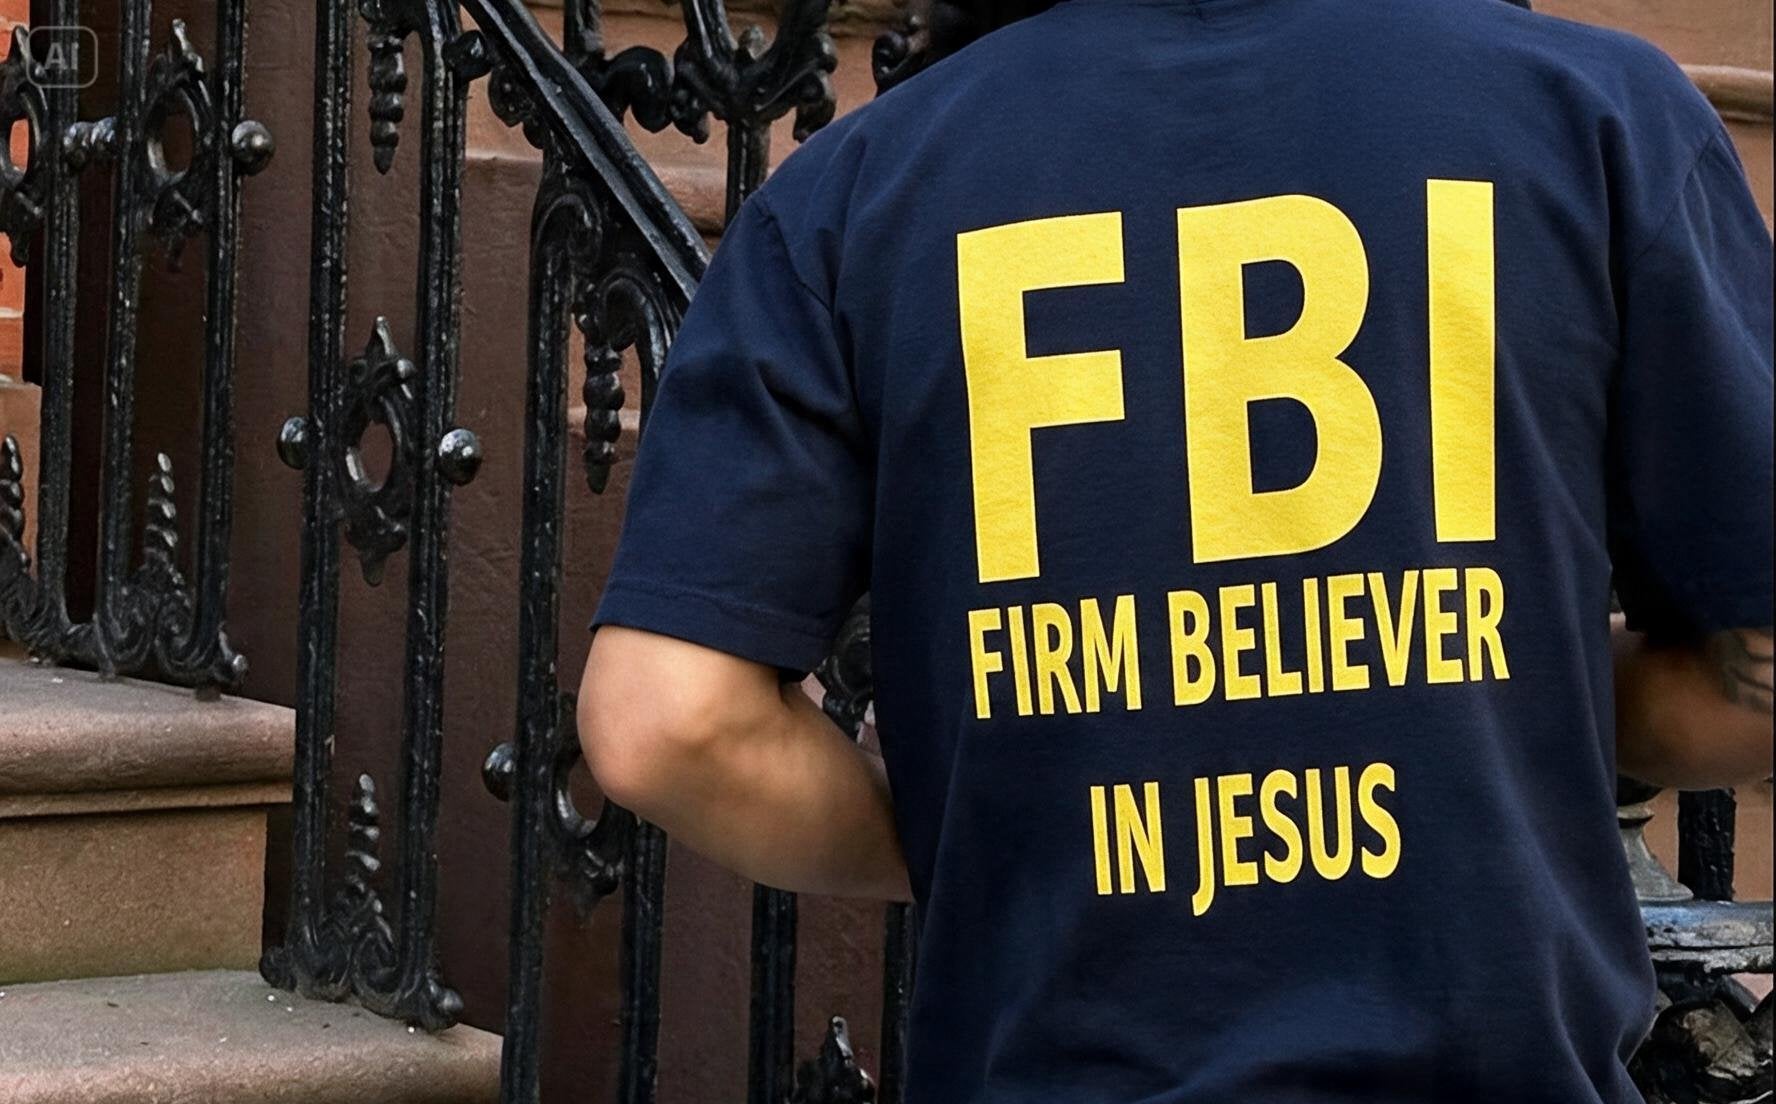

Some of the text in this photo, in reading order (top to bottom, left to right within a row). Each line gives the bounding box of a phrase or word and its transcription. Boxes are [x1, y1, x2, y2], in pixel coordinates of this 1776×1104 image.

[957, 179, 1496, 582] FBI
[968, 566, 1511, 719] FIRM BELIEVER
[1090, 763, 1402, 916] IN JESUS
